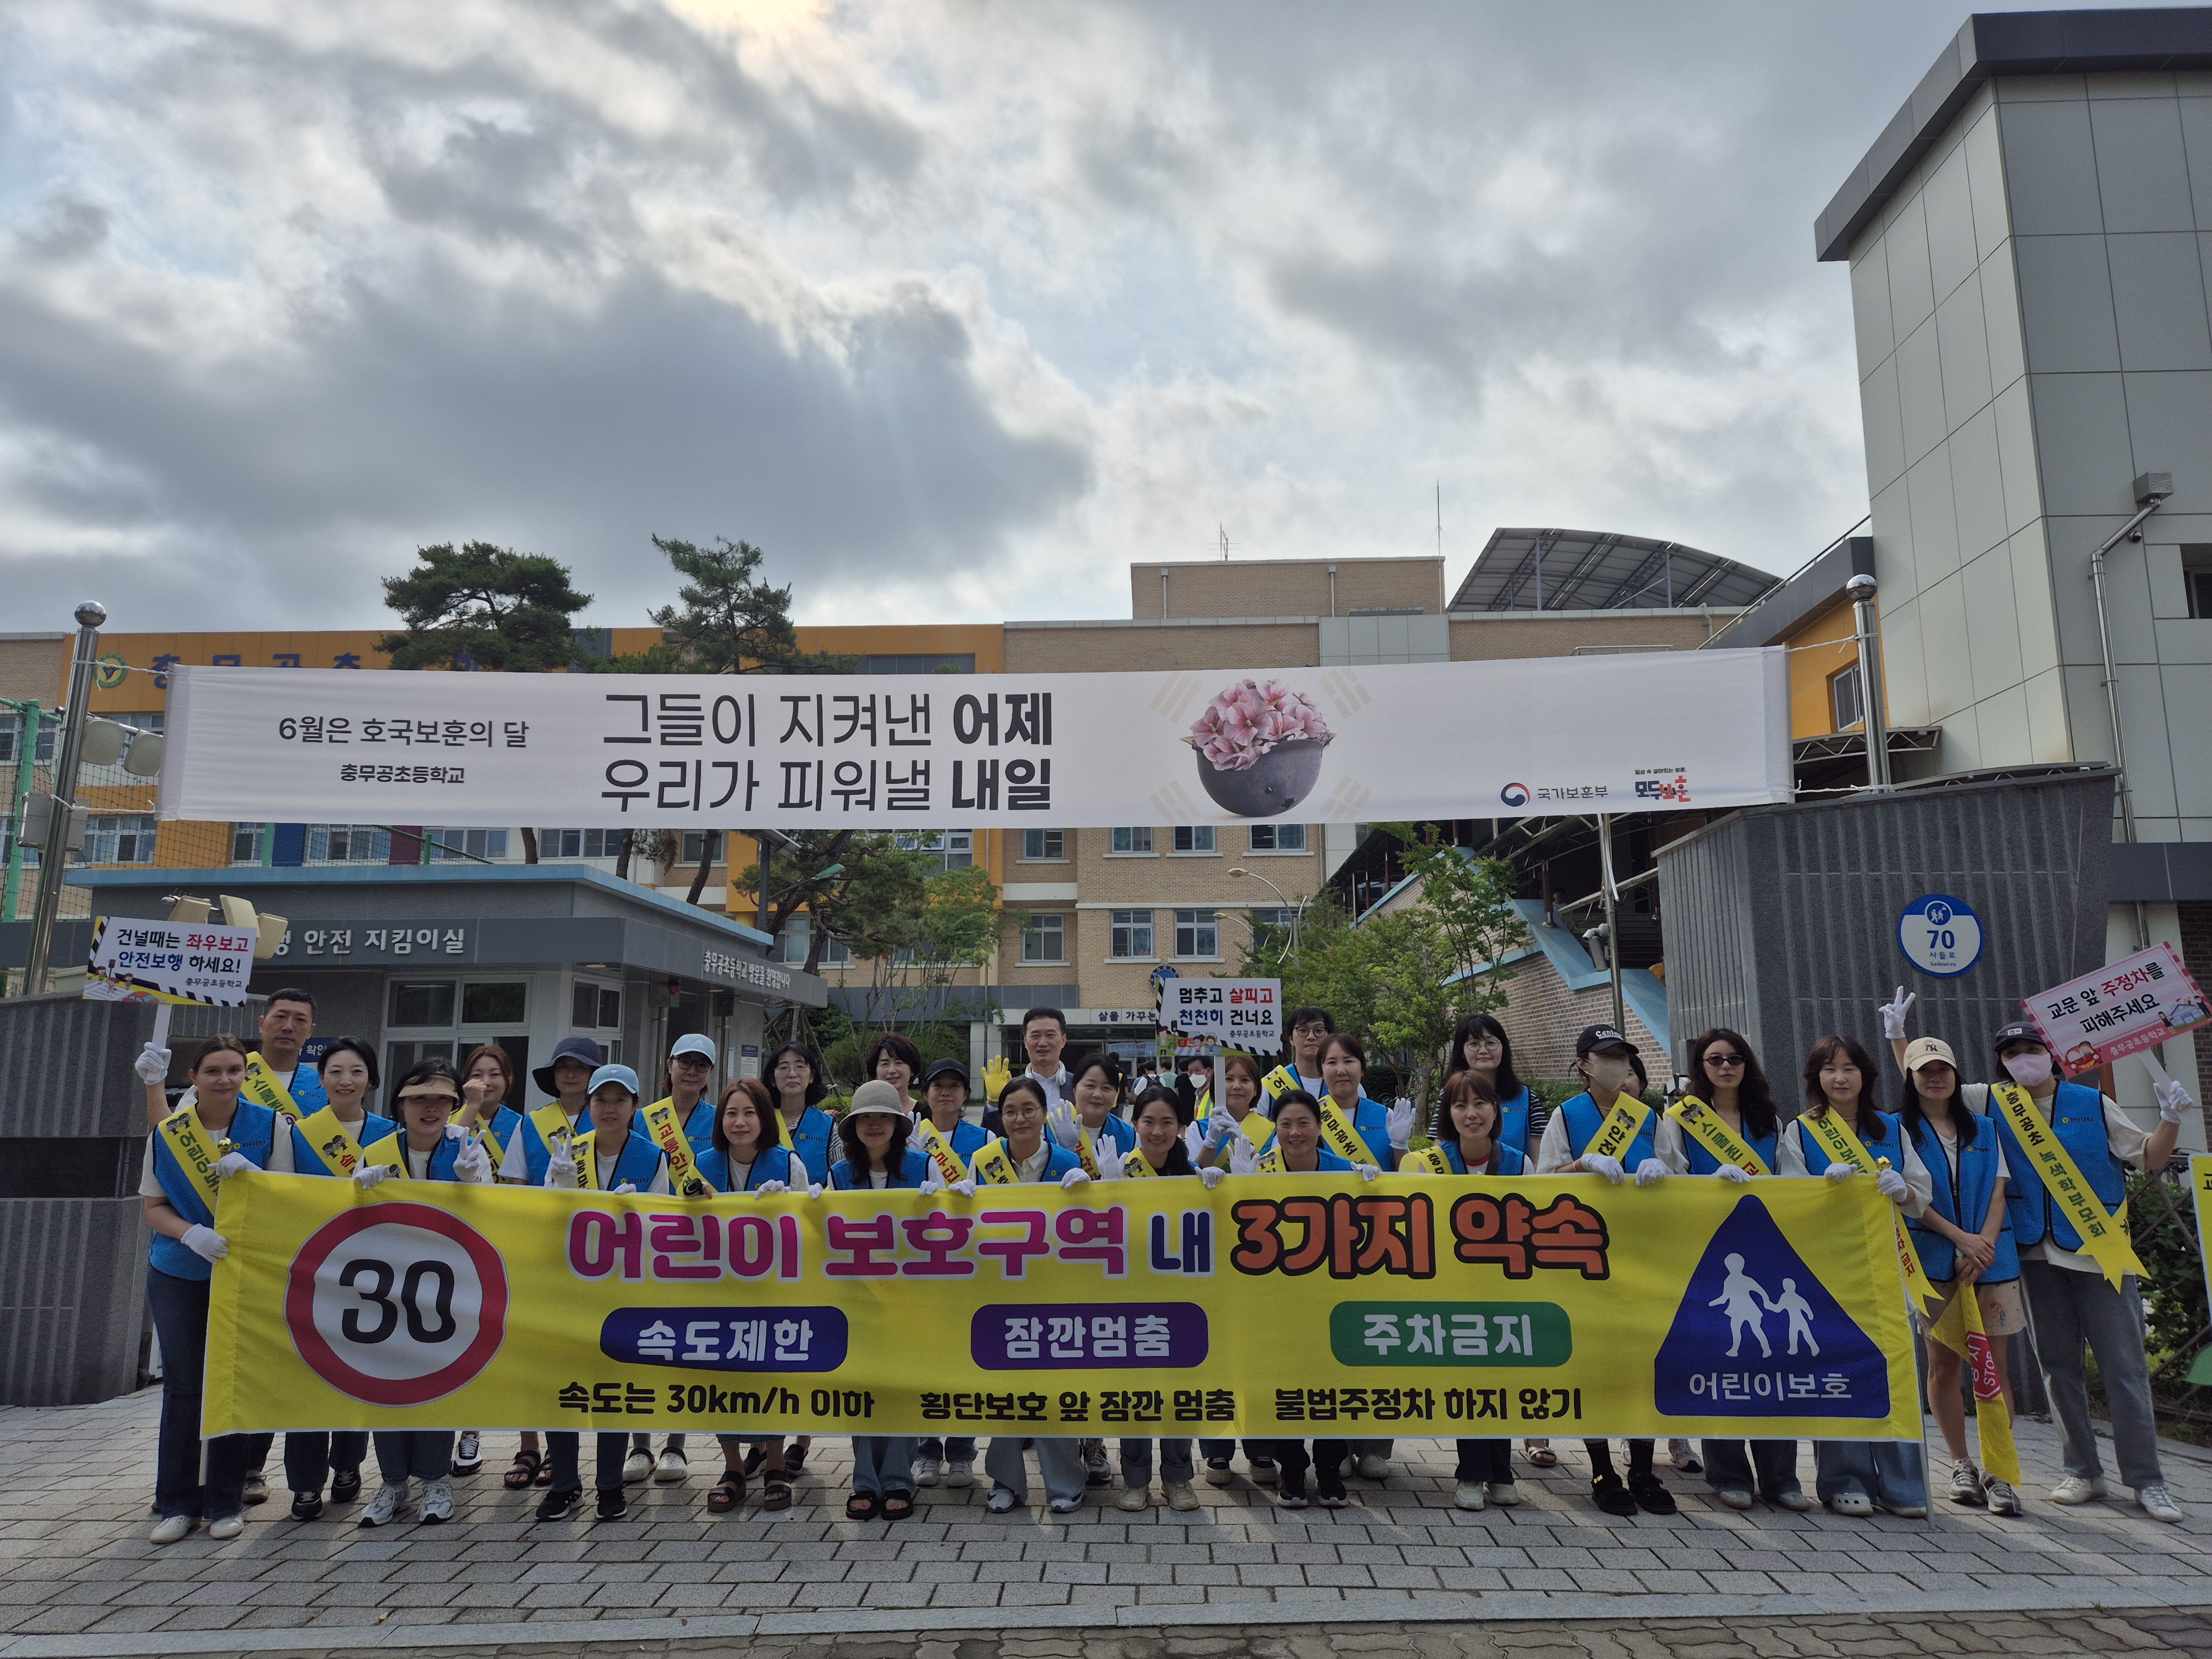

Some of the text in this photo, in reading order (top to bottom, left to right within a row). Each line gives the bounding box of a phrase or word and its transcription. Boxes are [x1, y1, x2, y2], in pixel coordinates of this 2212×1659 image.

[279, 716, 529, 748] 6월은 호국보훈의 달
[604, 692, 1052, 747] 그들이 지켜낸 어제
[340, 764, 465, 785] 충무공초등학교
[601, 759, 1051, 812] 우리가 피워낼 내일
[1537, 785, 1609, 800] 국가보훈부
[117, 928, 248, 952] 건널때는 좌우보고
[304, 929, 352, 954] 안전
[364, 928, 465, 954] 지킴이실
[1927, 930, 1955, 950] 70
[1929, 951, 1957, 960] 사들로
[118, 951, 241, 973] 안전보행 하세요!
[703, 950, 747, 979] 충무공초등학교
[185, 978, 243, 988] 충무공초등학교
[1179, 987, 1274, 1004] 멈추고 살피고
[2047, 961, 2165, 1020] 교문 앞 주정차를
[1098, 1011, 1120, 1022] 삶을
[1179, 1009, 1274, 1026] 천천히 건너요
[2079, 993, 2161, 1034] 피해주세요
[1229, 1030, 1275, 1039] 충무공초등학교
[2110, 1028, 2166, 1056] 충무공초등학교
[658, 1122, 688, 1180] 교통안
[1702, 1122, 1744, 1162] 스쿨존
[2005, 1091, 2046, 1146] 충무공초
[2038, 1150, 2107, 1238] 녹색학부모회
[568, 1192, 1610, 1281] 어린이 보호구역 내 3가지 약속
[338, 1258, 457, 1344] 30
[637, 1319, 813, 1361] 속도제한
[1004, 1315, 1171, 1359] 잠깐멈춤
[1363, 1313, 1533, 1357] 주차금지
[559, 1381, 875, 1418] 속도는 30km/h 이하
[1689, 1371, 1853, 1401] 어린이보호
[920, 1389, 1235, 1422] 횡단보호 앞 잠깐 멈춤
[1274, 1387, 1582, 1421] 불법주정차 하지 않기
